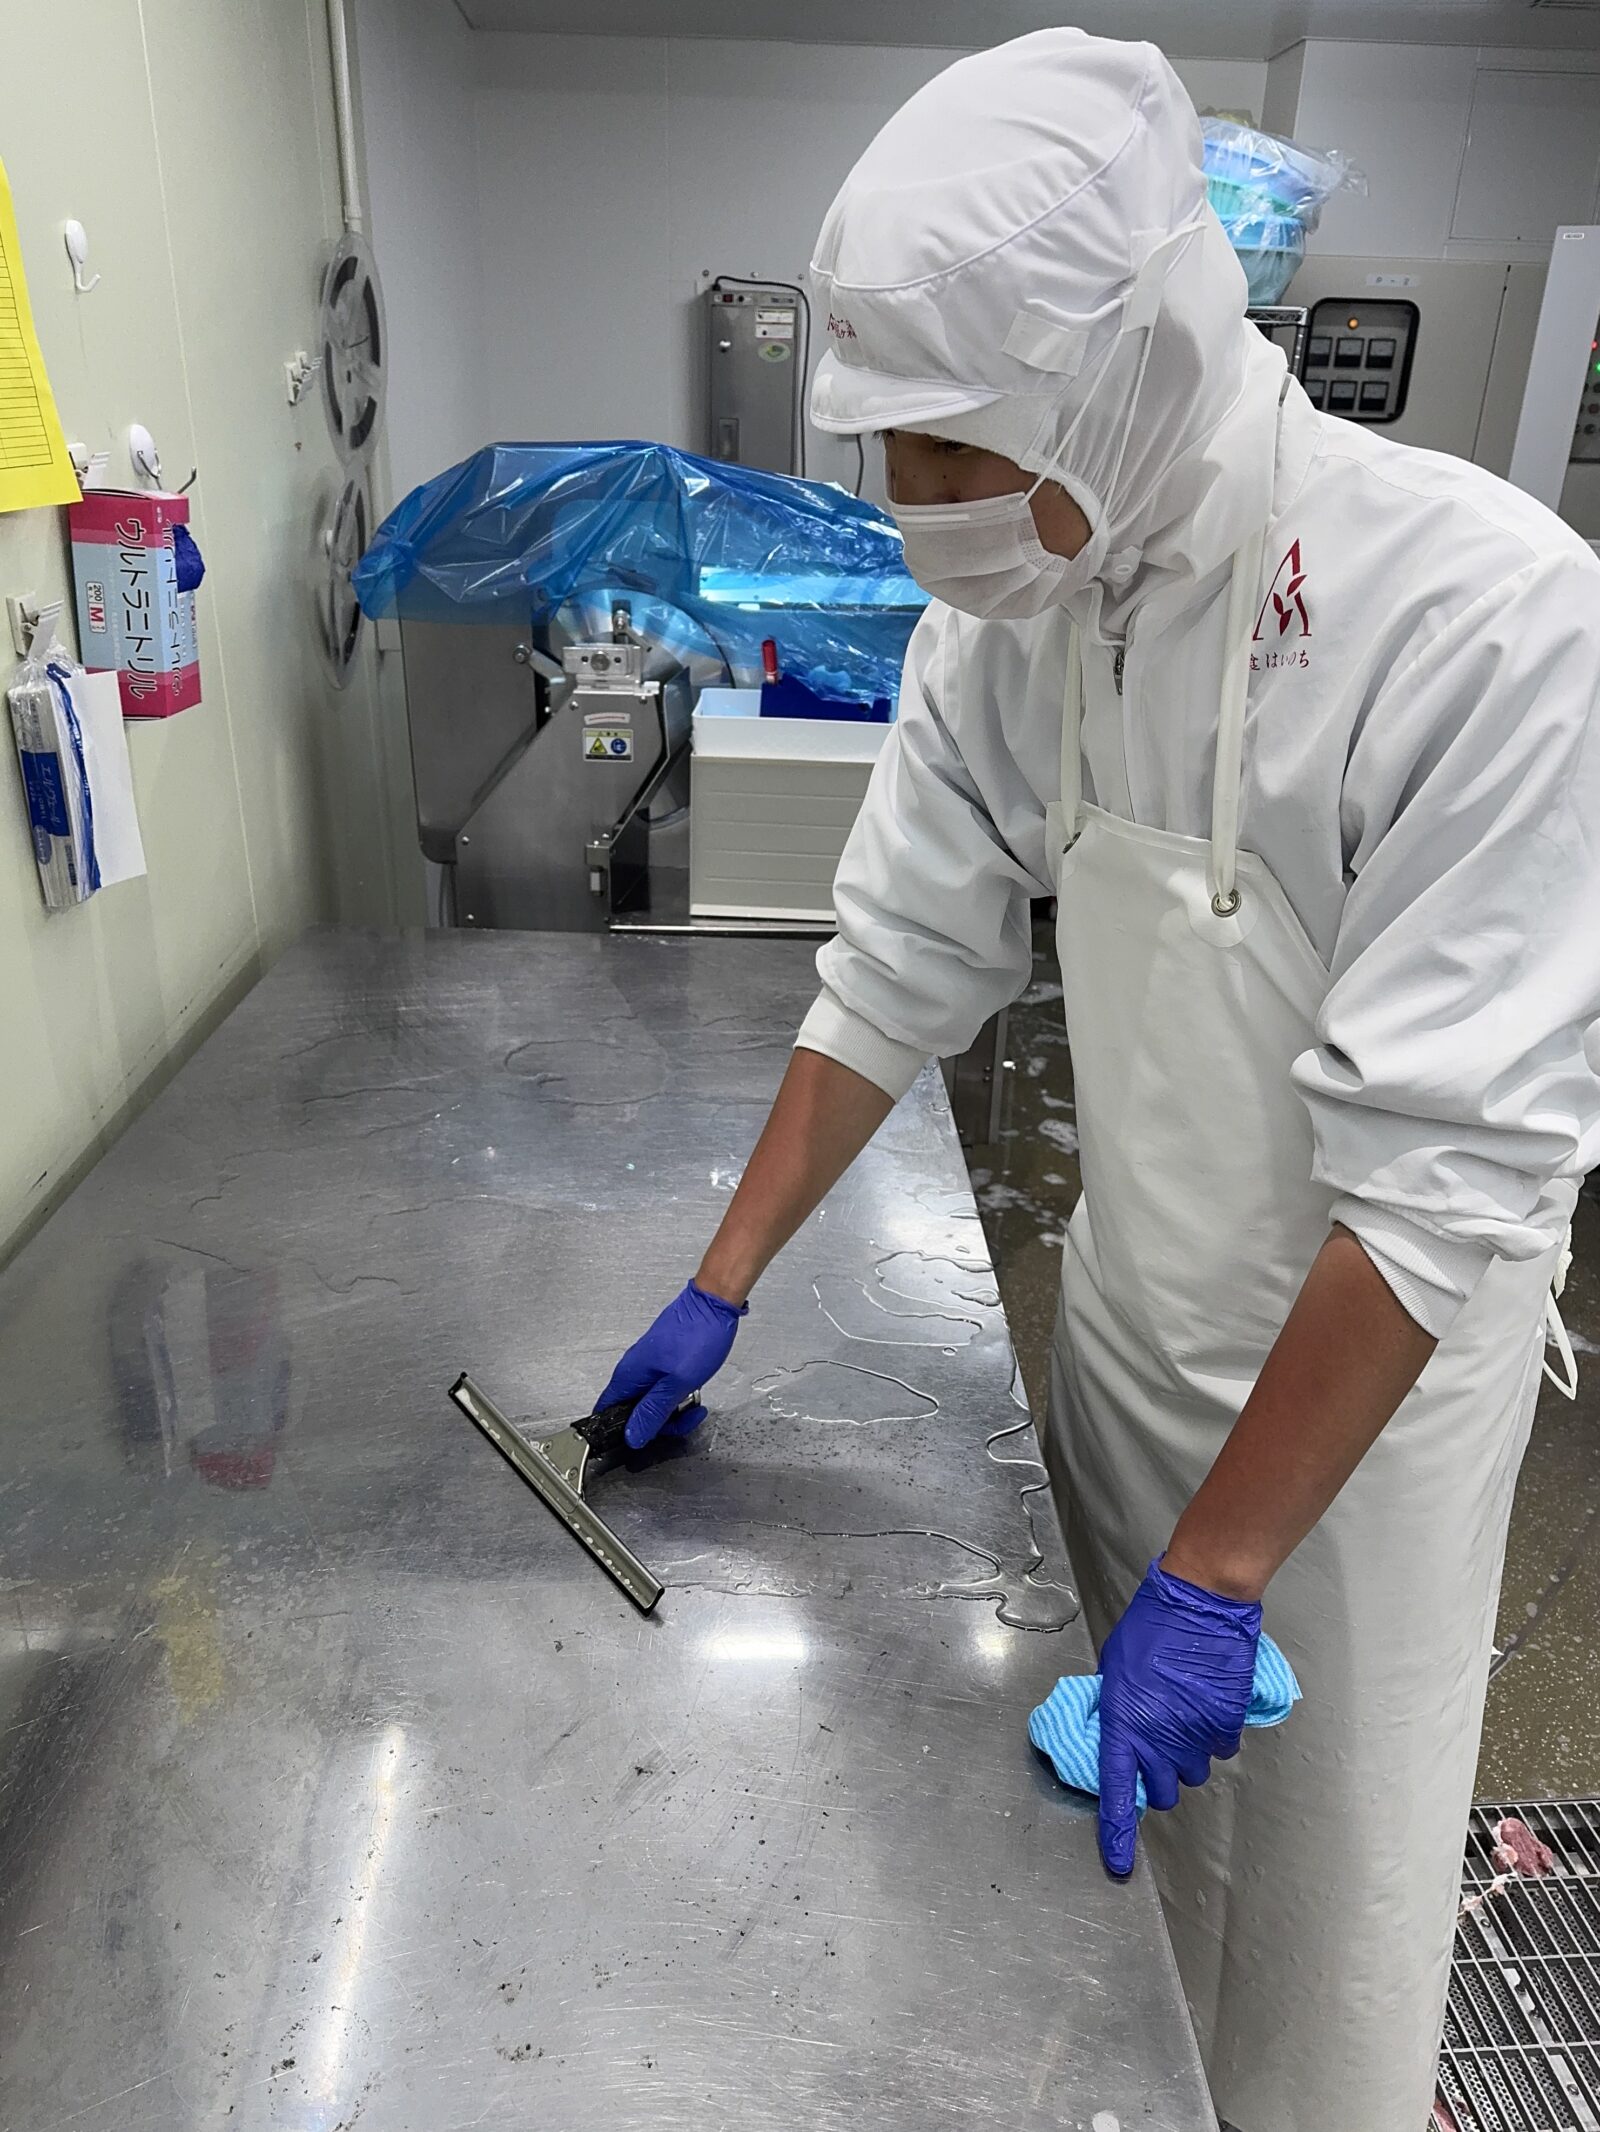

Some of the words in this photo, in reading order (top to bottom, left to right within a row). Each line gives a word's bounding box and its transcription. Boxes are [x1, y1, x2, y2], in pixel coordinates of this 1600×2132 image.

[94, 585, 103, 602] 200
[90, 607, 104, 622] M
[115, 518, 157, 699] ウルトラニトリル
